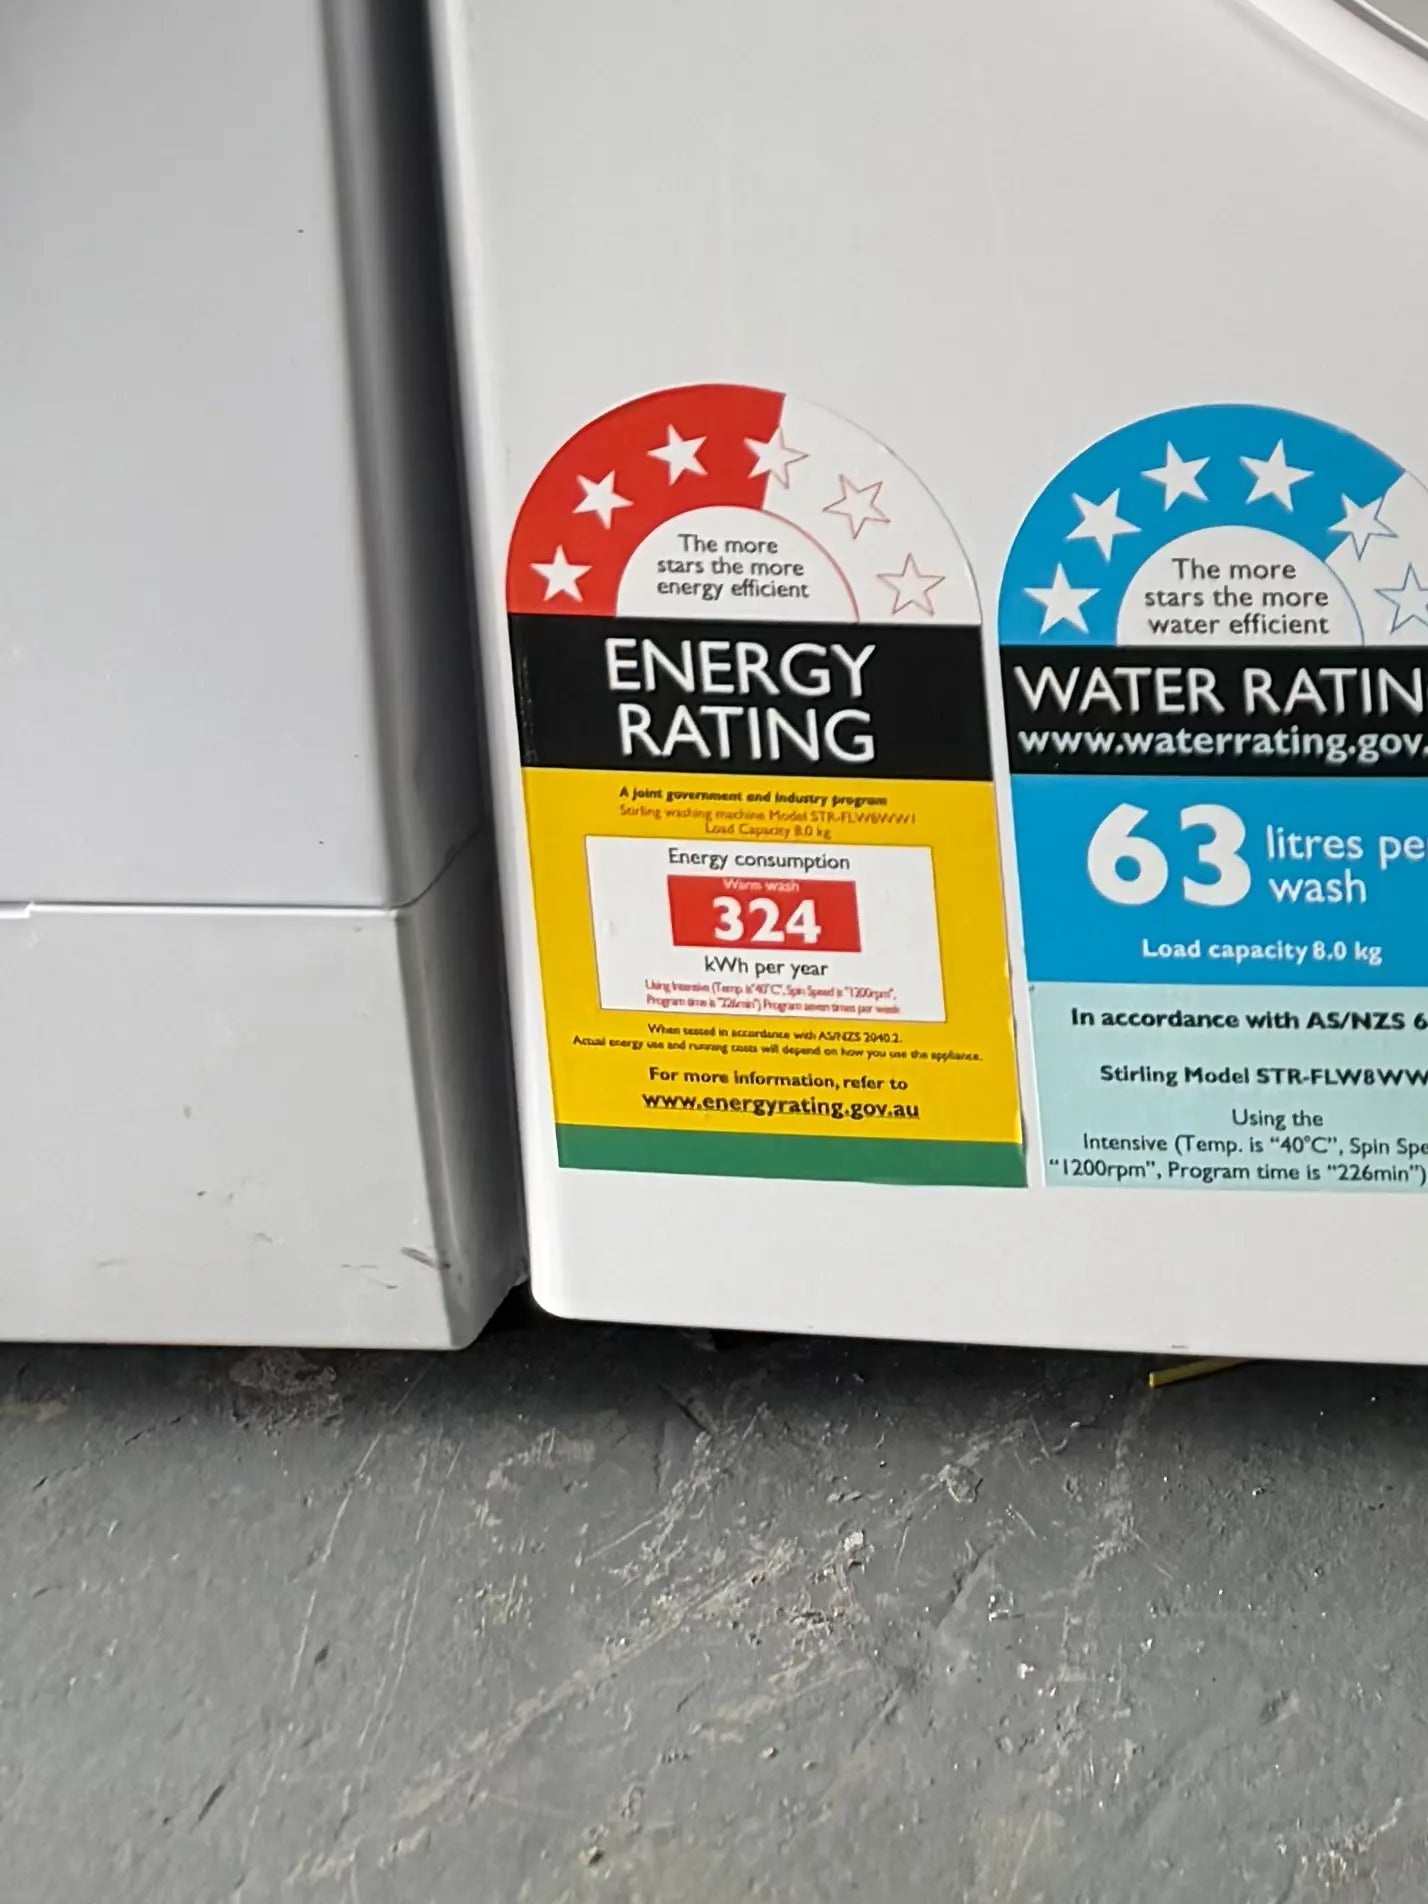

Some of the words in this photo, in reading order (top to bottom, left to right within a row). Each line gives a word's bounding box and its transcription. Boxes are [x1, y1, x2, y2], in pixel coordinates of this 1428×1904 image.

[678, 534, 718, 553] The
[725, 541, 778, 554] more
[657, 560, 704, 574] stars
[711, 556, 743, 575] the
[751, 563, 804, 576] more
[1172, 558, 1220, 579] The
[1230, 565, 1296, 580] more
[657, 582, 723, 601] energy
[731, 578, 809, 598] efficient
[1145, 591, 1204, 607] stars
[1213, 585, 1253, 607] the
[1263, 592, 1328, 607] more
[1148, 618, 1220, 634] water
[1229, 613, 1329, 634] efficient
[605, 638, 875, 696] ENERGY
[1014, 666, 1224, 713] WATER
[619, 703, 874, 762] RATING
[619, 786, 629, 797] A
[631, 788, 662, 801] joint
[664, 791, 742, 802] government
[745, 792, 773, 803] and
[774, 791, 828, 806] industry
[832, 795, 887, 808] program
[1087, 803, 1251, 906] 63
[1266, 825, 1363, 860] litres
[669, 847, 728, 870] Energy
[735, 854, 850, 873] consumption
[722, 877, 762, 890] Warm
[765, 879, 800, 892] wash
[1269, 868, 1366, 903] wash
[714, 897, 821, 943] 324
[1142, 939, 1201, 958] Load
[1208, 941, 1308, 965] capacity
[1312, 941, 1347, 960] 8.0
[1354, 941, 1382, 966] kg
[705, 955, 748, 973] kWh
[755, 963, 785, 979] per
[790, 964, 828, 980] year
[1072, 1008, 1095, 1025] In
[1101, 1010, 1239, 1028] accordance
[1246, 1011, 1299, 1029] with
[1306, 1012, 1405, 1030] AS/NZS
[648, 1066, 678, 1081] For
[683, 1072, 728, 1085] more
[733, 1070, 840, 1090] information,
[842, 1076, 884, 1090] refer
[889, 1079, 908, 1090] to
[1101, 1065, 1178, 1087] Stirling
[1185, 1067, 1249, 1084] Model
[642, 1094, 919, 1121] www.energyrating.gov.au
[1232, 1109, 1286, 1131] Using
[1292, 1110, 1323, 1127] the
[1084, 1133, 1167, 1151] Intensive
[1175, 1135, 1242, 1157] (Temp.
[1250, 1137, 1263, 1153] is
[1350, 1137, 1389, 1159] Spin
[1168, 1161, 1249, 1183] Program
[1257, 1164, 1299, 1180] time
[1307, 1165, 1321, 1180] is
